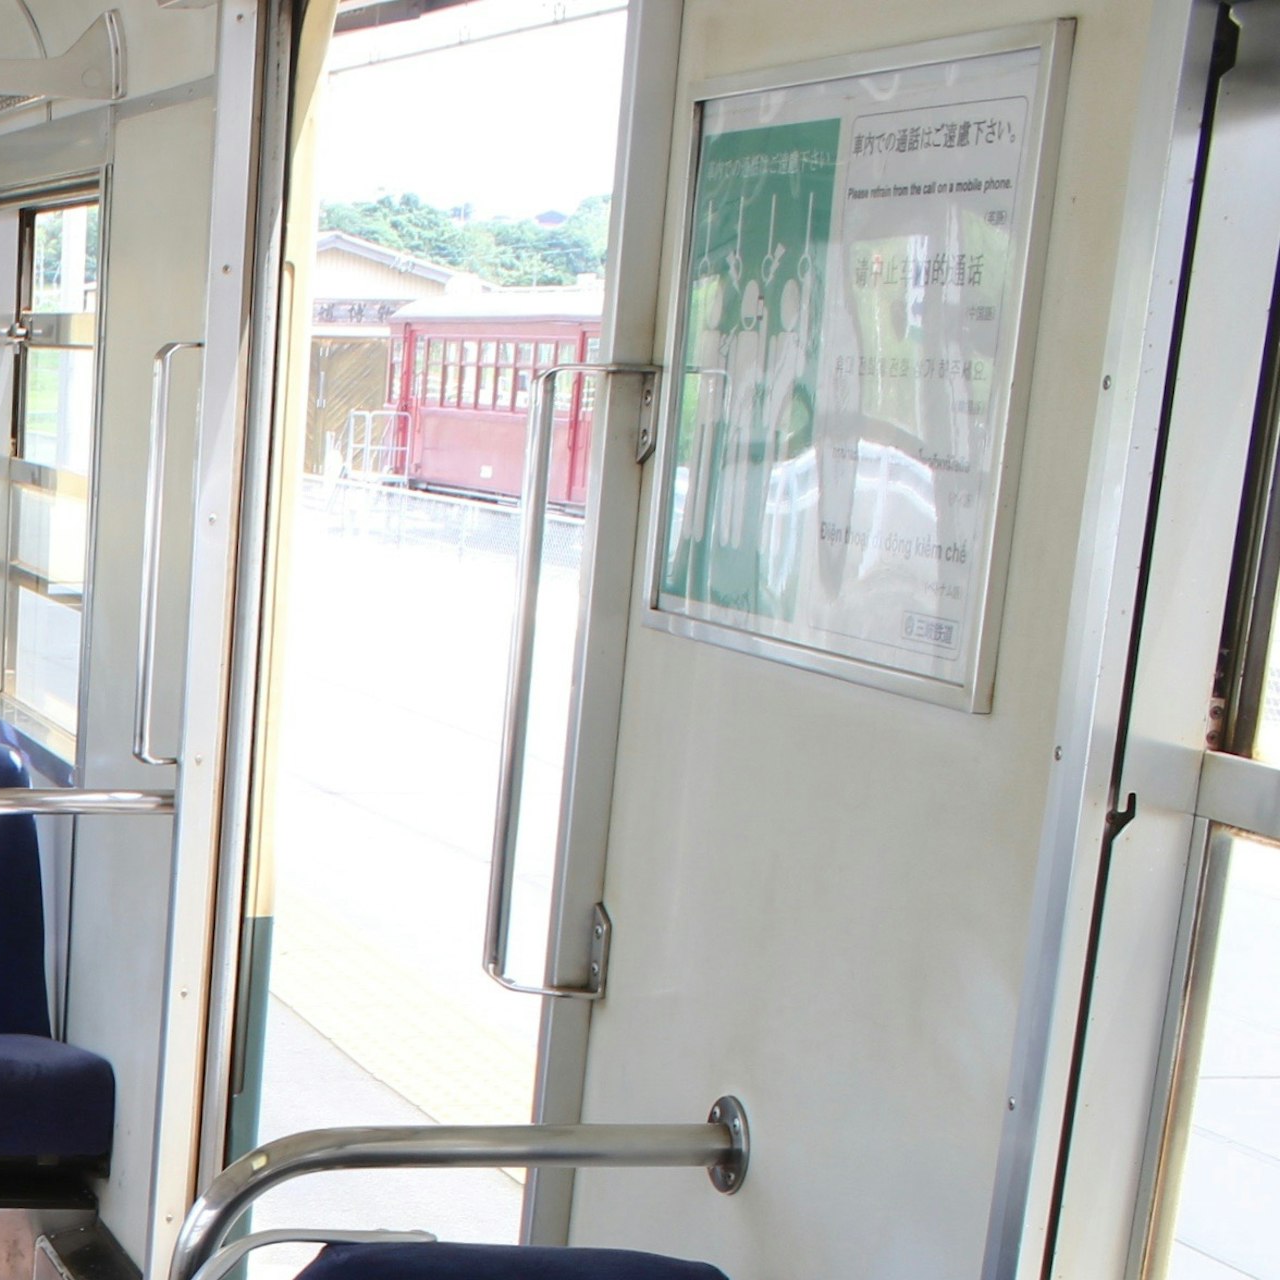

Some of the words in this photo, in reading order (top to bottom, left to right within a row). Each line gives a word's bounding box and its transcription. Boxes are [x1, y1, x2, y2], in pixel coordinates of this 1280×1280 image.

[852, 118, 1017, 157] 車内での通話はご遠慮下さい。
[848, 187, 869, 200] Please
[870, 185, 891, 199] refrain
[893, 184, 908, 197] from
[910, 183, 921, 196] the
[923, 181, 936, 195] call
[938, 183, 947, 193] on
[956, 178, 982, 192] mobile
[983, 177, 1012, 194] phone.
[945, 537, 967, 565] chế
